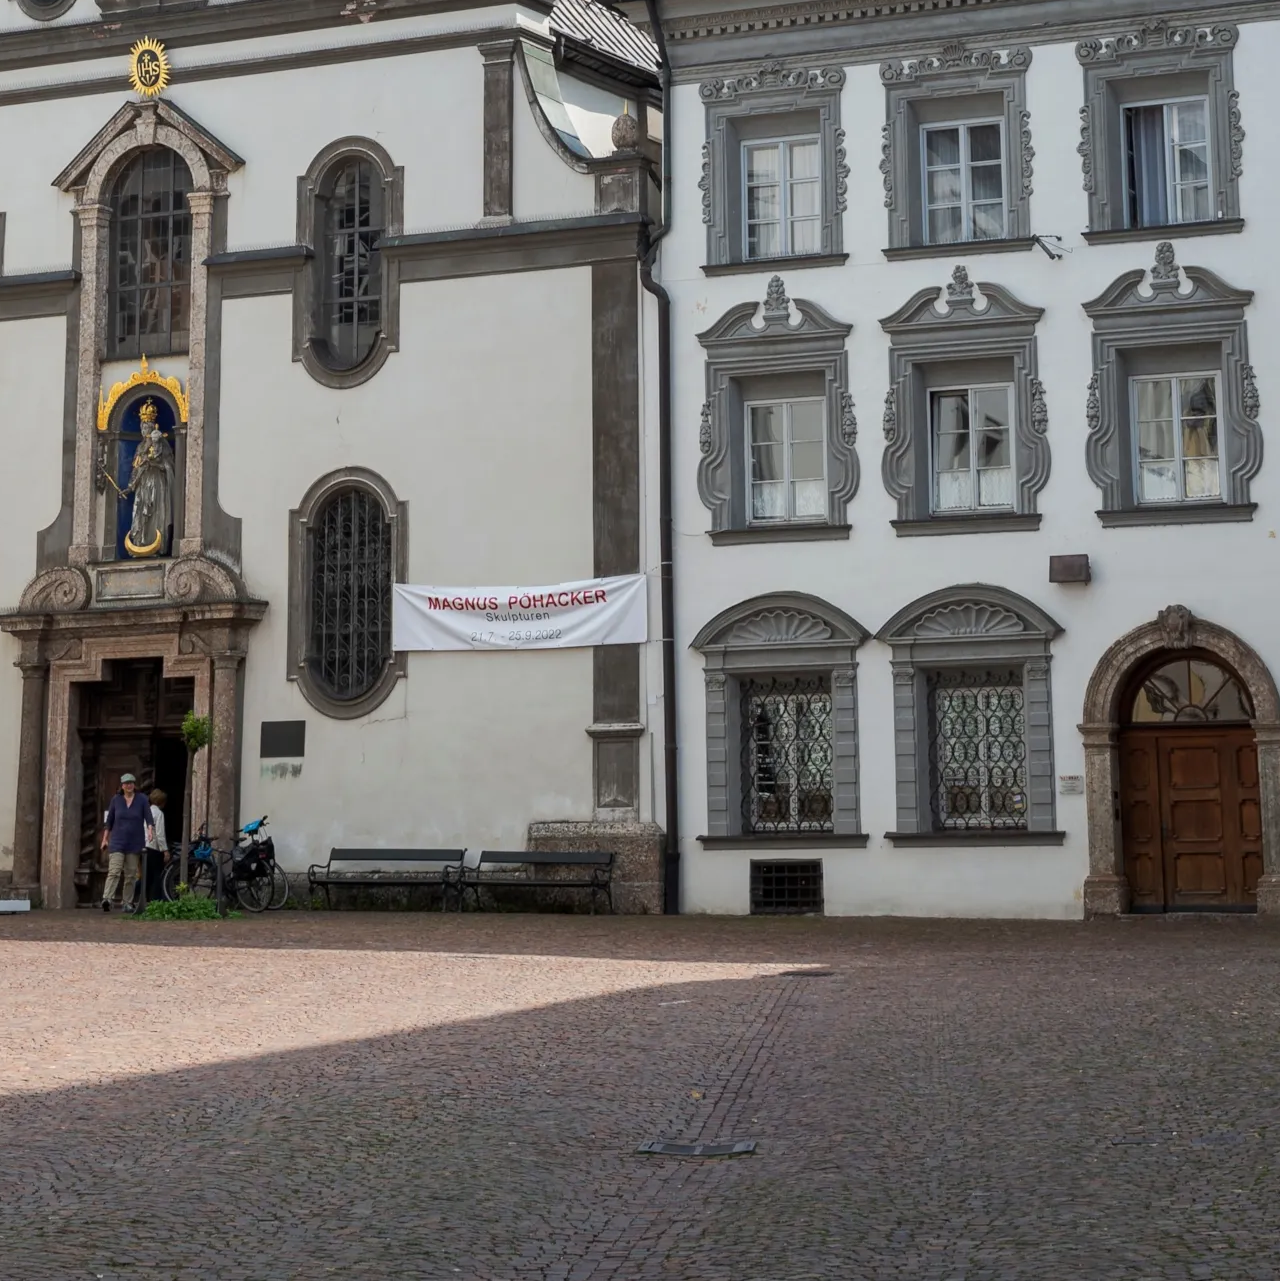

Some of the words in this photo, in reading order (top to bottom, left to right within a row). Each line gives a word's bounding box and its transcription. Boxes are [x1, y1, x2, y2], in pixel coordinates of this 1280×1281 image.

[138, 61, 160, 77] IHS
[428, 596, 498, 611] MAGNUS
[508, 589, 607, 610] PÖHACKER
[485, 611, 550, 623] Skulpturen
[471, 632, 496, 642] 21.7.
[508, 629, 562, 641] 25.9.2022
